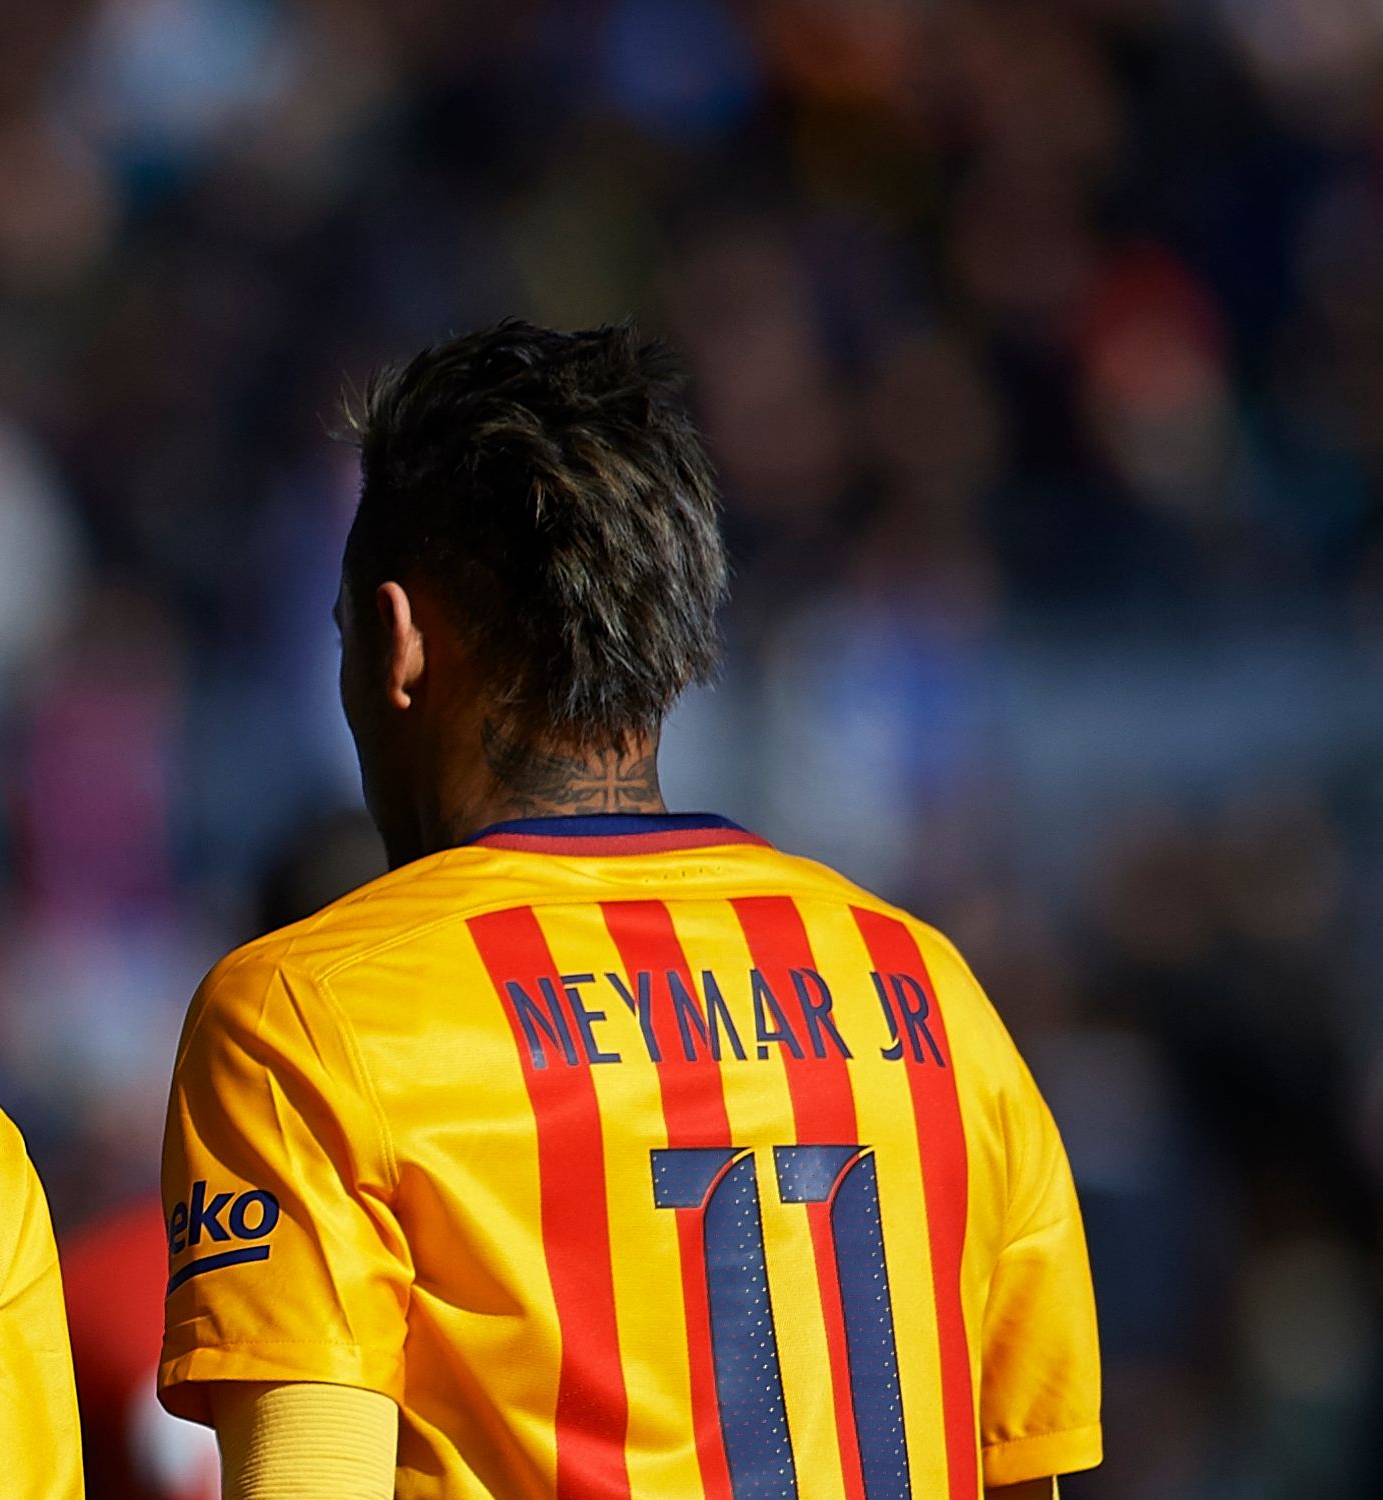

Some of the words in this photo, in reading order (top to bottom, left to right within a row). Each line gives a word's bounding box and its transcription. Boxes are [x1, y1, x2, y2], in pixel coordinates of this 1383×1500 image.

[505, 968, 854, 1069] NEYMAR
[869, 970, 946, 1069] JR
[169, 1180, 280, 1255] eko
